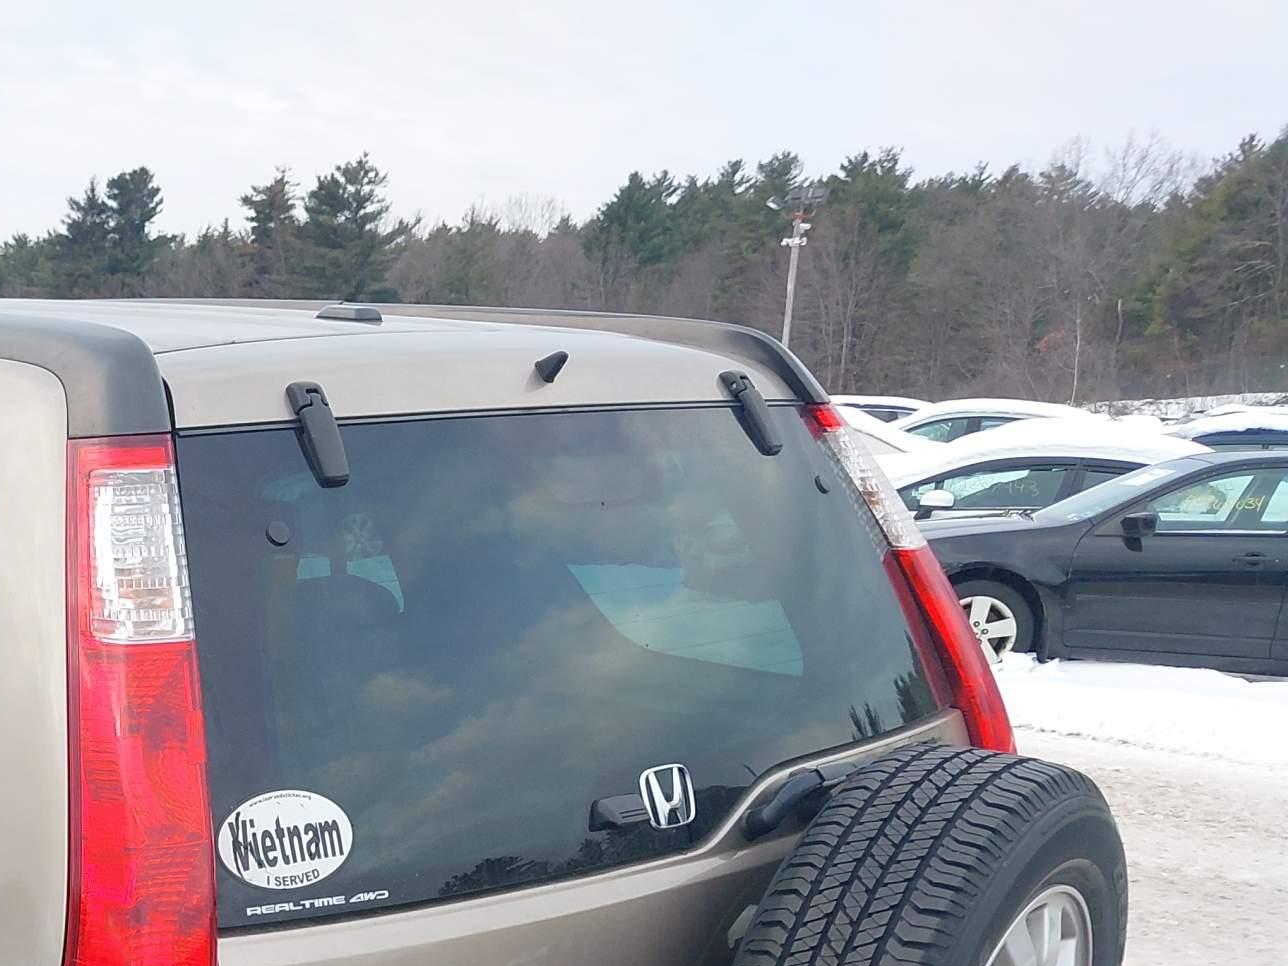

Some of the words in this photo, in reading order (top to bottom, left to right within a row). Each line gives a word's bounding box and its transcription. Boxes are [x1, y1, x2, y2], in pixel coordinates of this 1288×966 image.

[228, 816, 345, 873] Vietnam
[266, 875, 271, 886] I
[274, 868, 320, 887] SERVED
[246, 895, 346, 916] REALTIME
